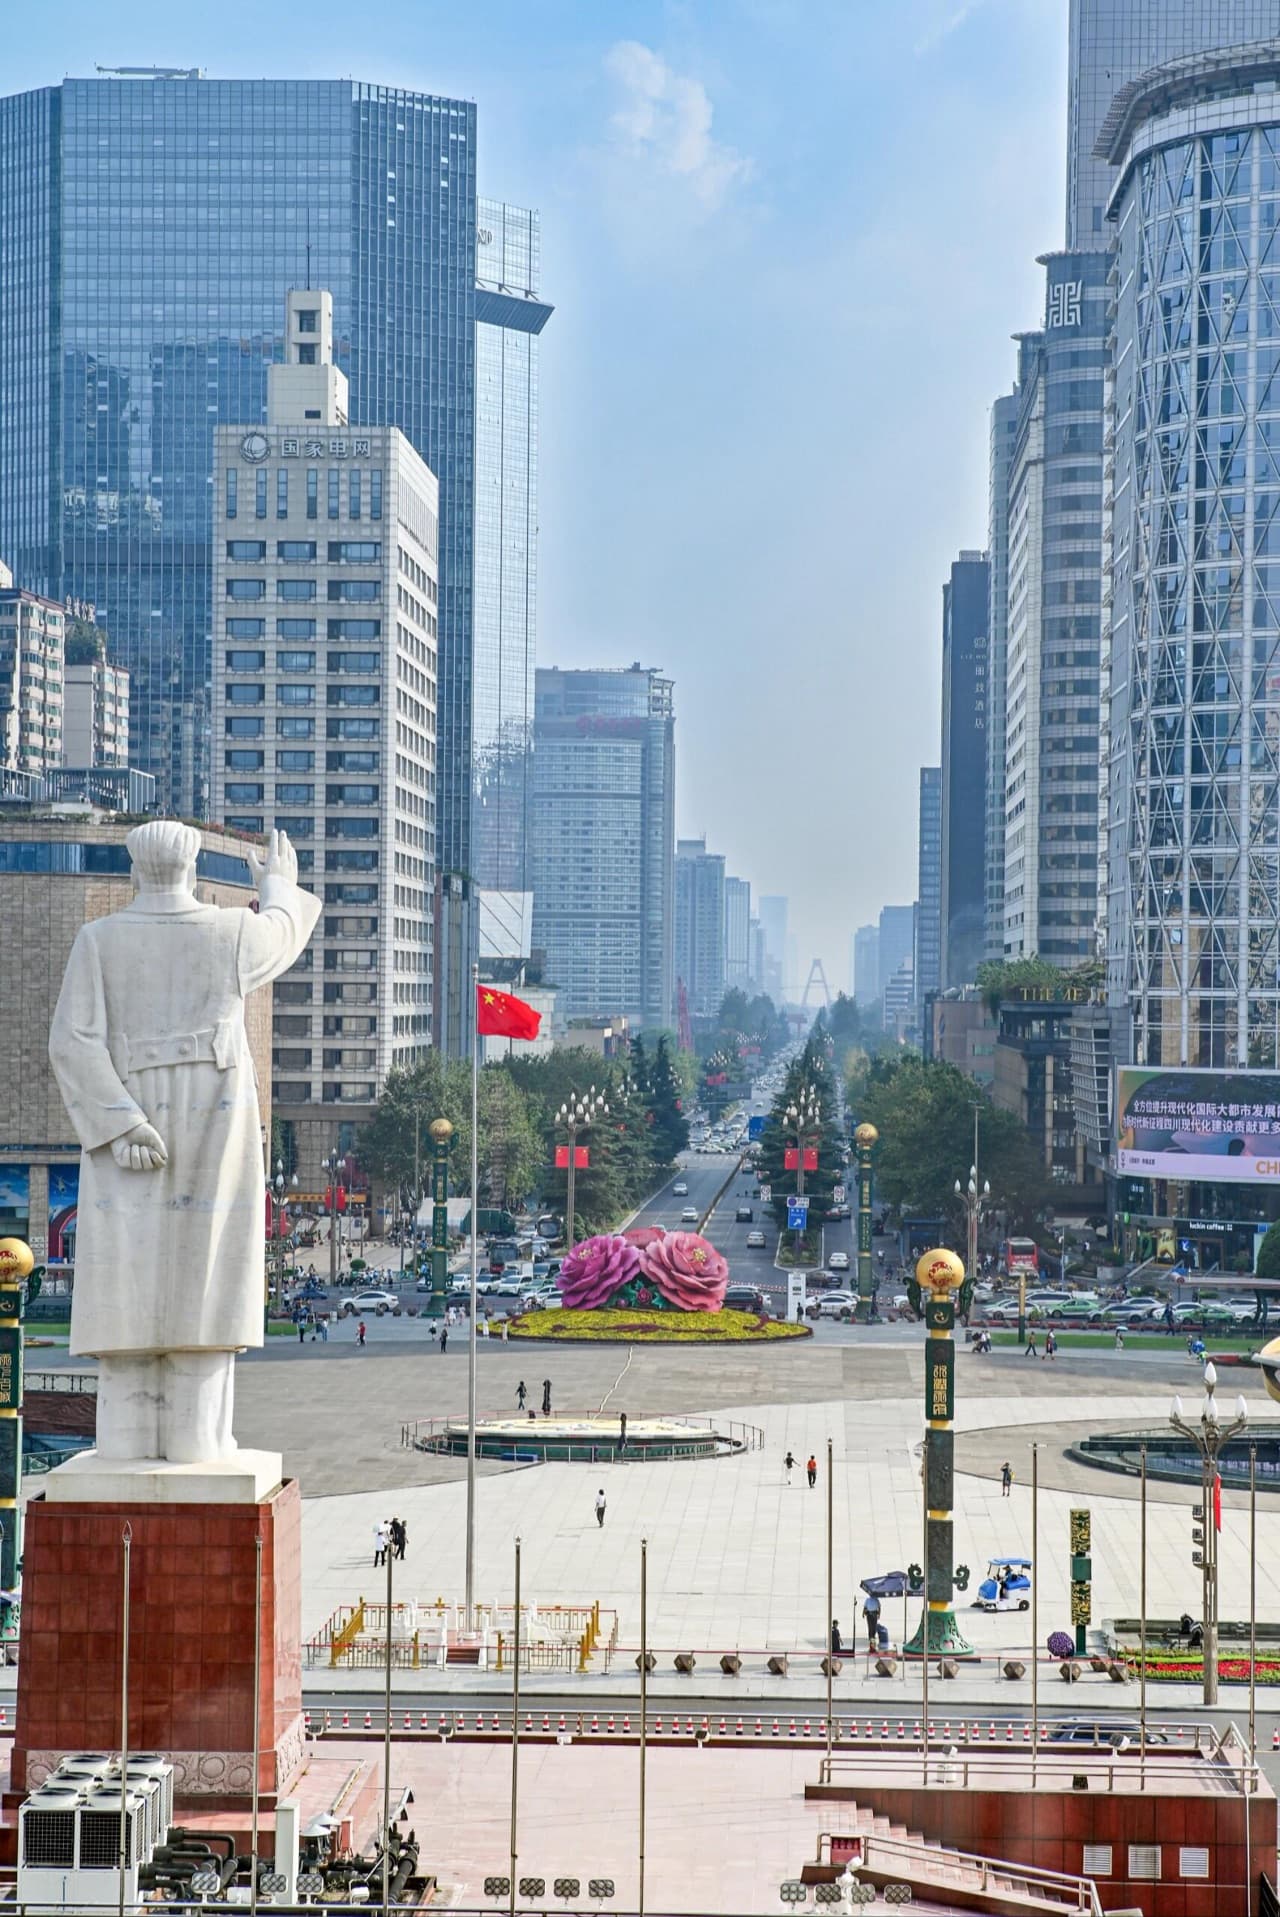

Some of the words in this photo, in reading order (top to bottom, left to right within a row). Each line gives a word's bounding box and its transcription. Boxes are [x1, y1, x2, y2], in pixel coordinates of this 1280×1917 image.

[280, 438, 371, 459] 国家电网
[1255, 1160, 1280, 1175] CH
[1189, 1221, 1206, 1230] luckin
[1206, 1223, 1225, 1231] coffee
